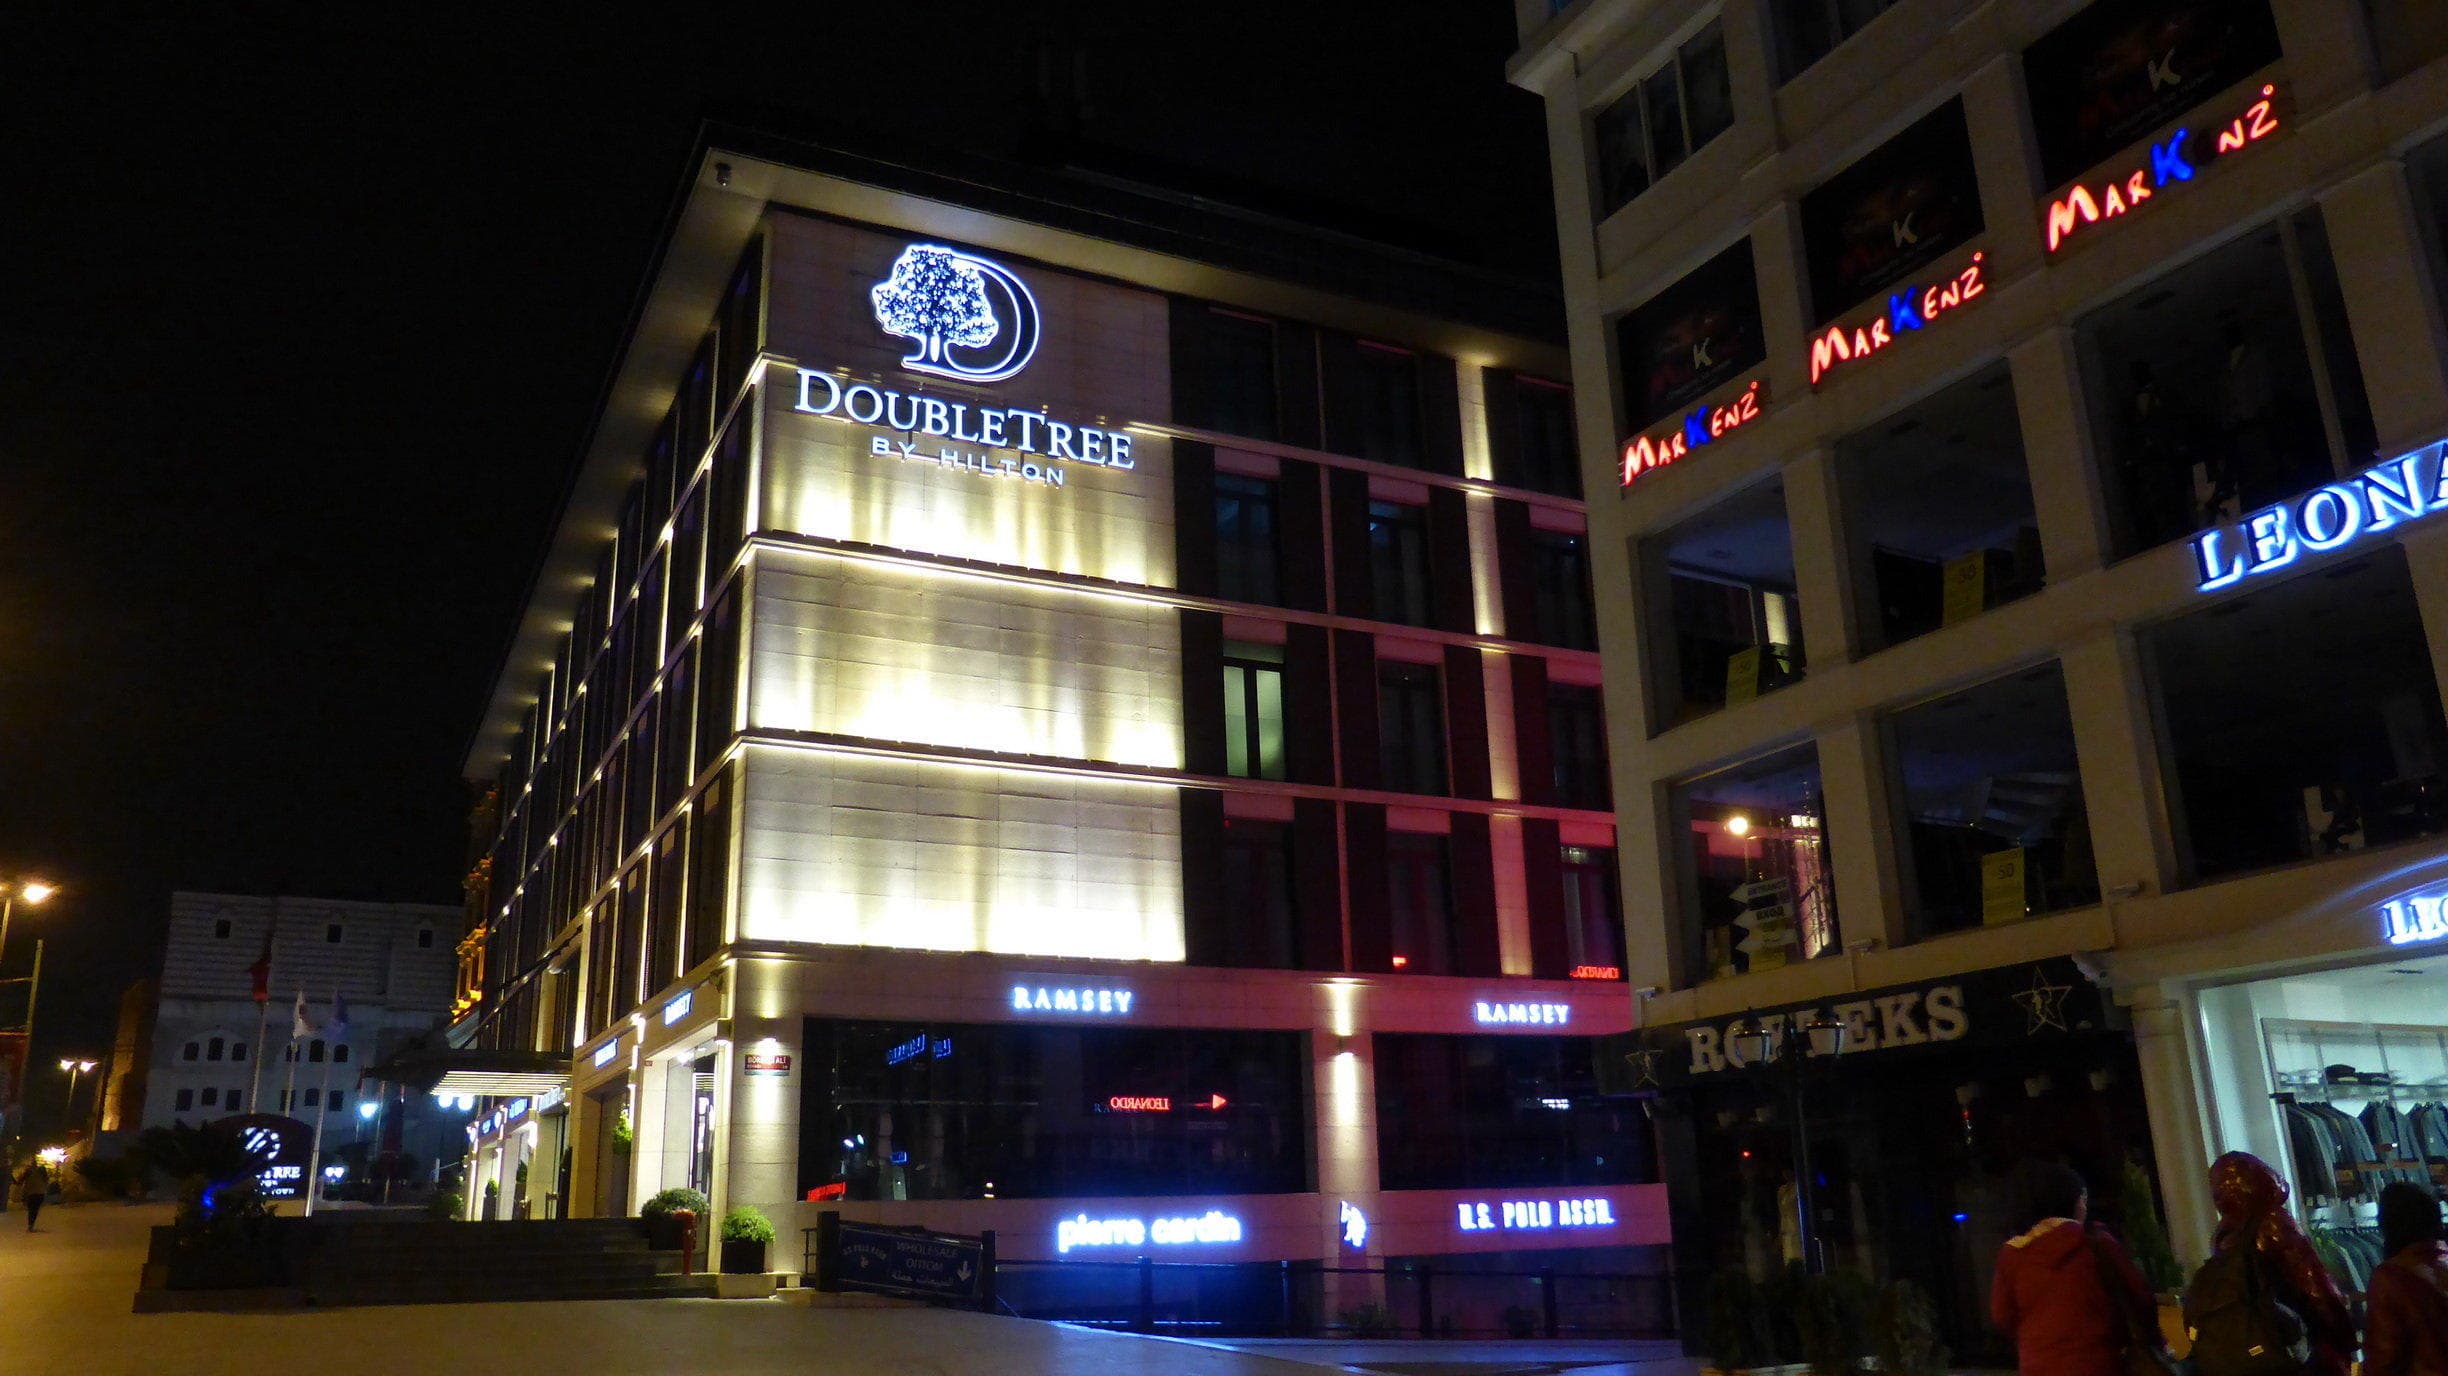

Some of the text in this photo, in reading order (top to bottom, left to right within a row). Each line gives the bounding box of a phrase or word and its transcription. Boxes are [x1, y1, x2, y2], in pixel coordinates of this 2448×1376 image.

[872, 436, 1064, 487] BY HILTON
[1014, 985, 1132, 1013] RAMSEY
[1475, 1001, 1570, 1024] RAMSEY
[1502, 1201, 1552, 1228] POLO
[1058, 1211, 1241, 1253] pierre cardin
